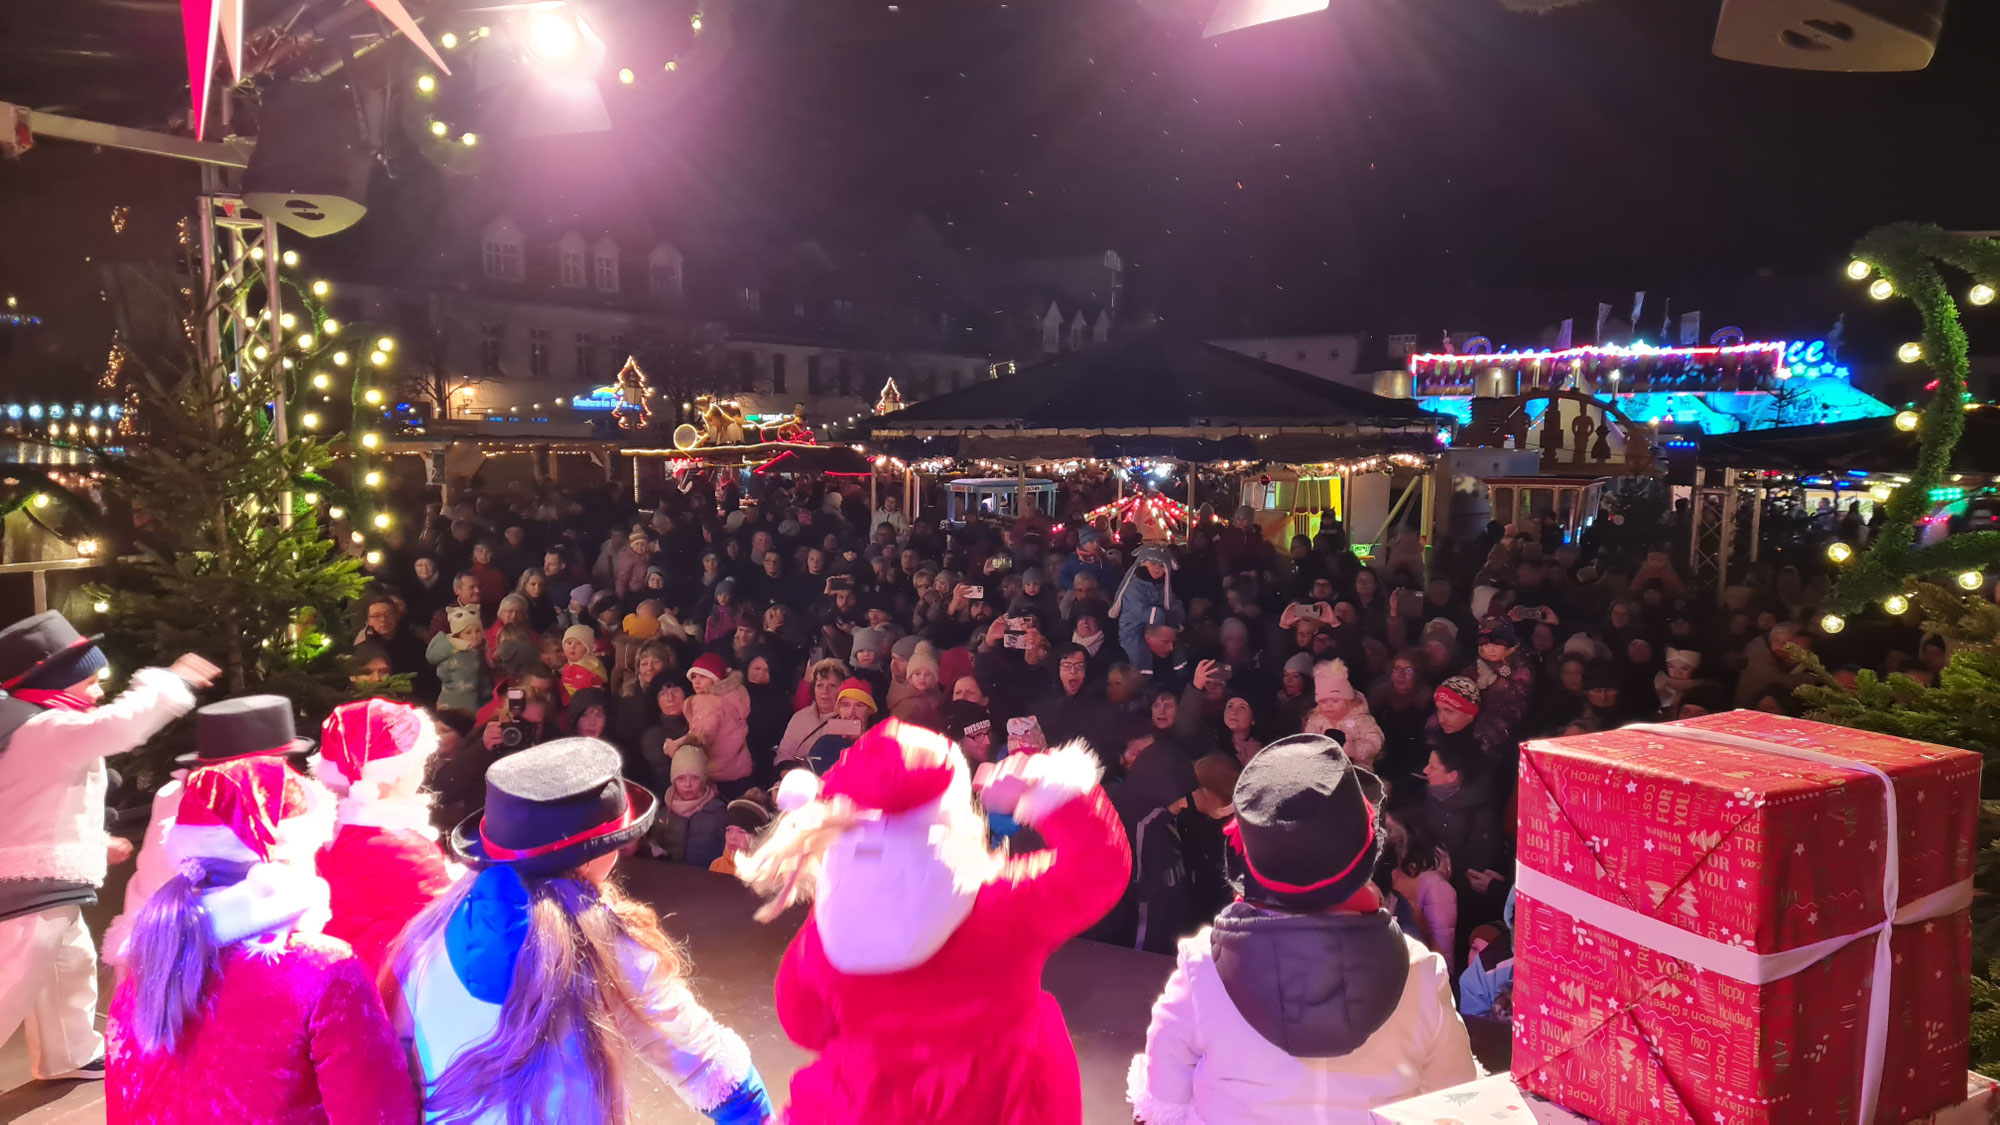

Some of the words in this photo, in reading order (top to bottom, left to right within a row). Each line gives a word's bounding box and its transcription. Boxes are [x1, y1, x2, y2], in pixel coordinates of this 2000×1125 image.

[1570, 770, 1601, 785] HOPE
[1643, 784, 1656, 819] COSY
[1656, 788, 1674, 824] FOR
[1673, 792, 1691, 826] YOU
[1526, 832, 1551, 852] FOR
[1658, 841, 1682, 857] Best
[1734, 836, 1765, 854] TRE
[1524, 850, 1551, 867] COSY
[1707, 852, 1730, 872] OR
[1698, 868, 1730, 891] YOU
[1637, 945, 1650, 970] TRE
[1656, 958, 1679, 976] YO
[1546, 990, 1573, 1009] Peace
[1718, 979, 1745, 1005] Happy
[1718, 1003, 1753, 1030] Holidays
[1529, 1018, 1538, 1052] HOPE
[1540, 1019, 1572, 1045] SNOW
[1540, 1039, 1569, 1056] TRE
[1647, 1053, 1658, 1096] ERRY
[1715, 1043, 1728, 1083] HOPE
[1567, 1085, 1598, 1106] HOPE
